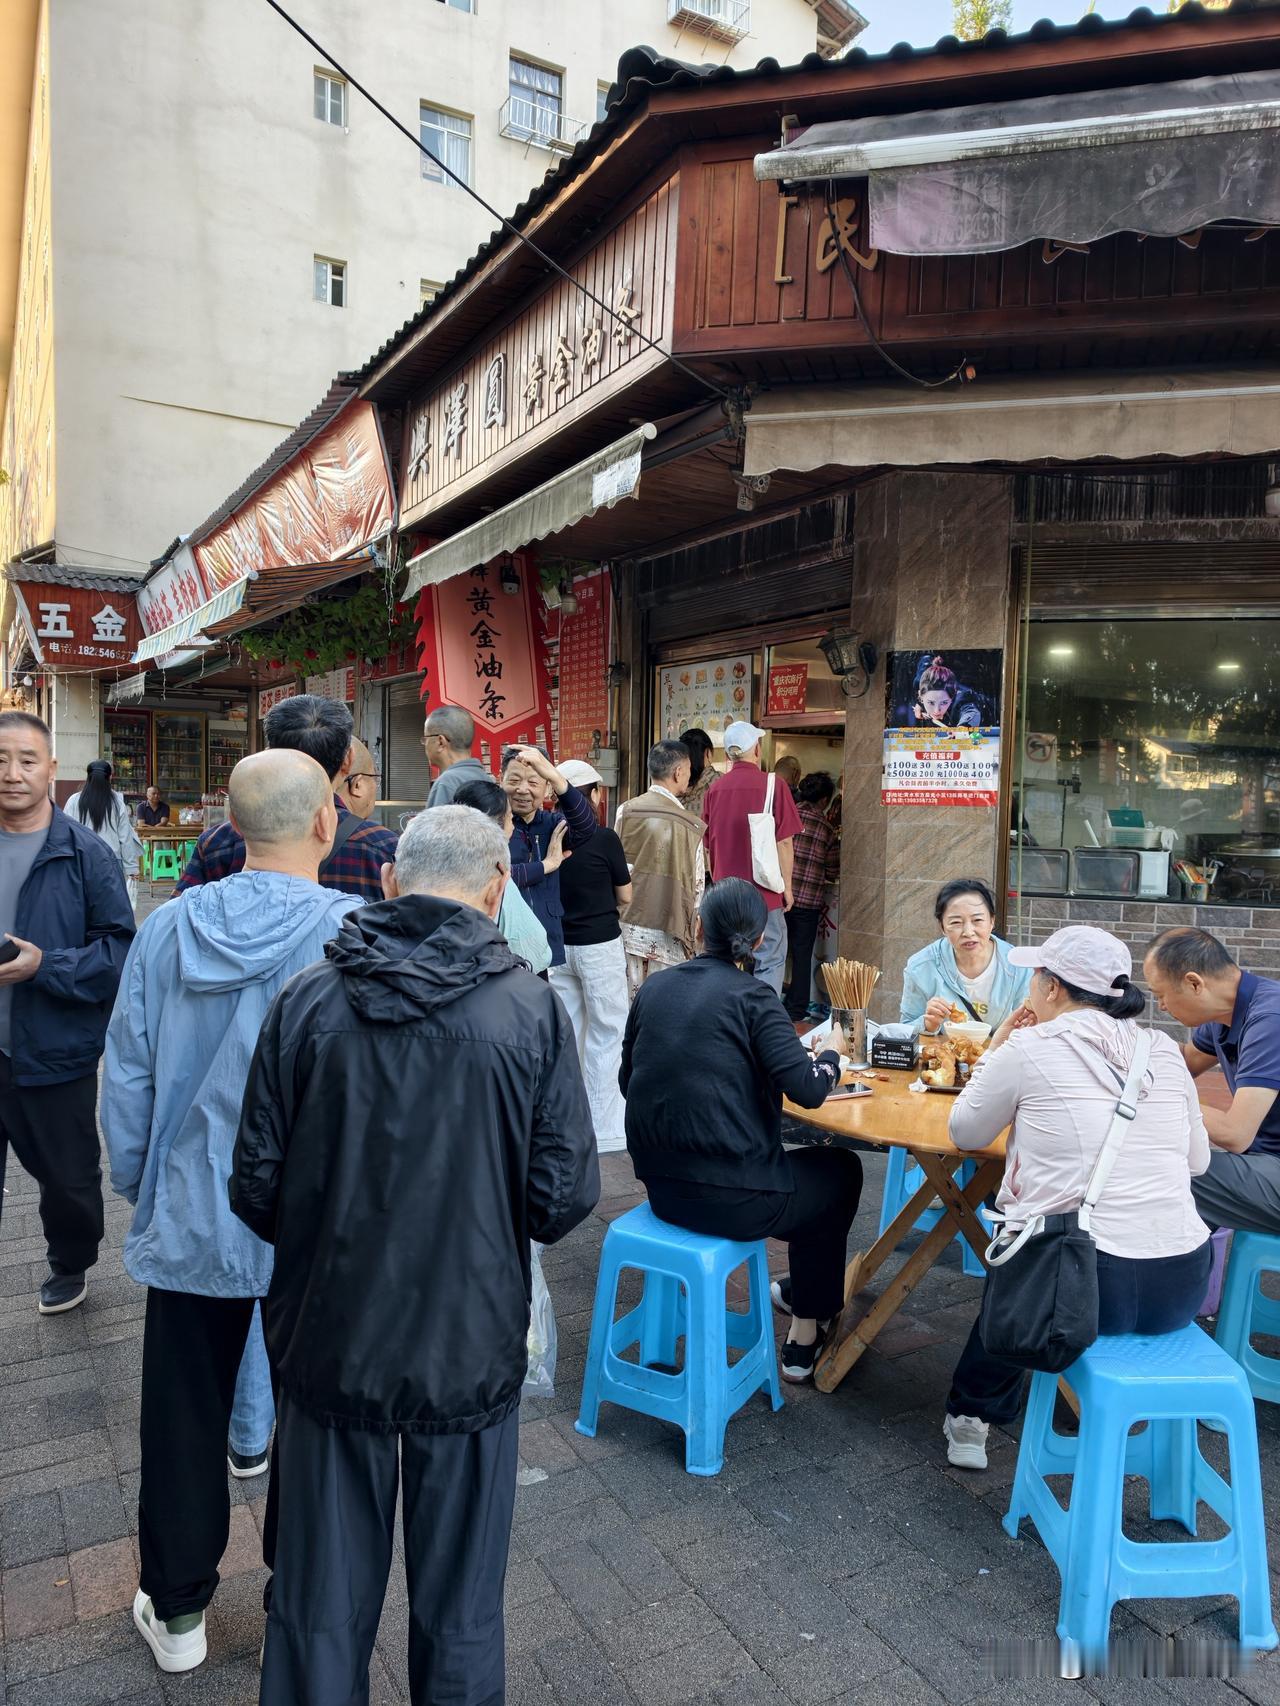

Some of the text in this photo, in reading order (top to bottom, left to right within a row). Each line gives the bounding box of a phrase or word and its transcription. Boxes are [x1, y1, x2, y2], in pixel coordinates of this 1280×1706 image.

[37, 602, 127, 642] 五金
[922, 752, 955, 760] 充值福利
